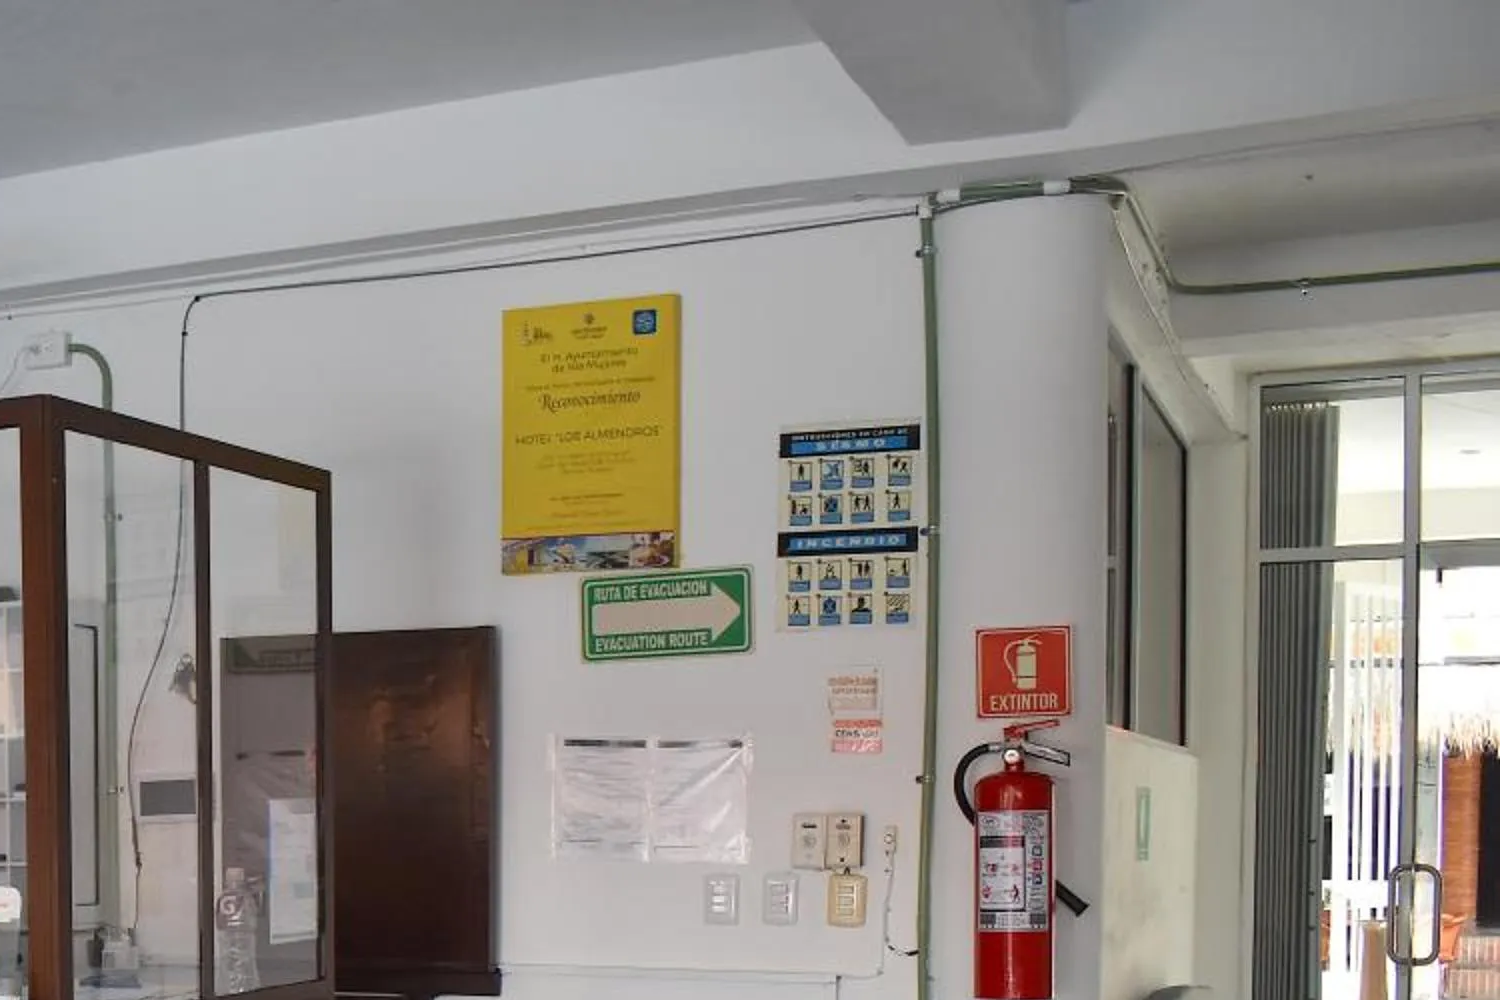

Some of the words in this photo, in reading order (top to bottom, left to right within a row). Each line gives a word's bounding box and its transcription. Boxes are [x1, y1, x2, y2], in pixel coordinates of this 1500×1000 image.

[537, 390, 641, 413] Reconocimiento
[797, 535, 900, 549] INCENDIO
[593, 585, 622, 601] RUTA
[624, 585, 637, 599] DE
[595, 634, 666, 652] EVACUATION
[669, 631, 709, 648] ROUTE
[990, 693, 1060, 711] EXTINTOR
